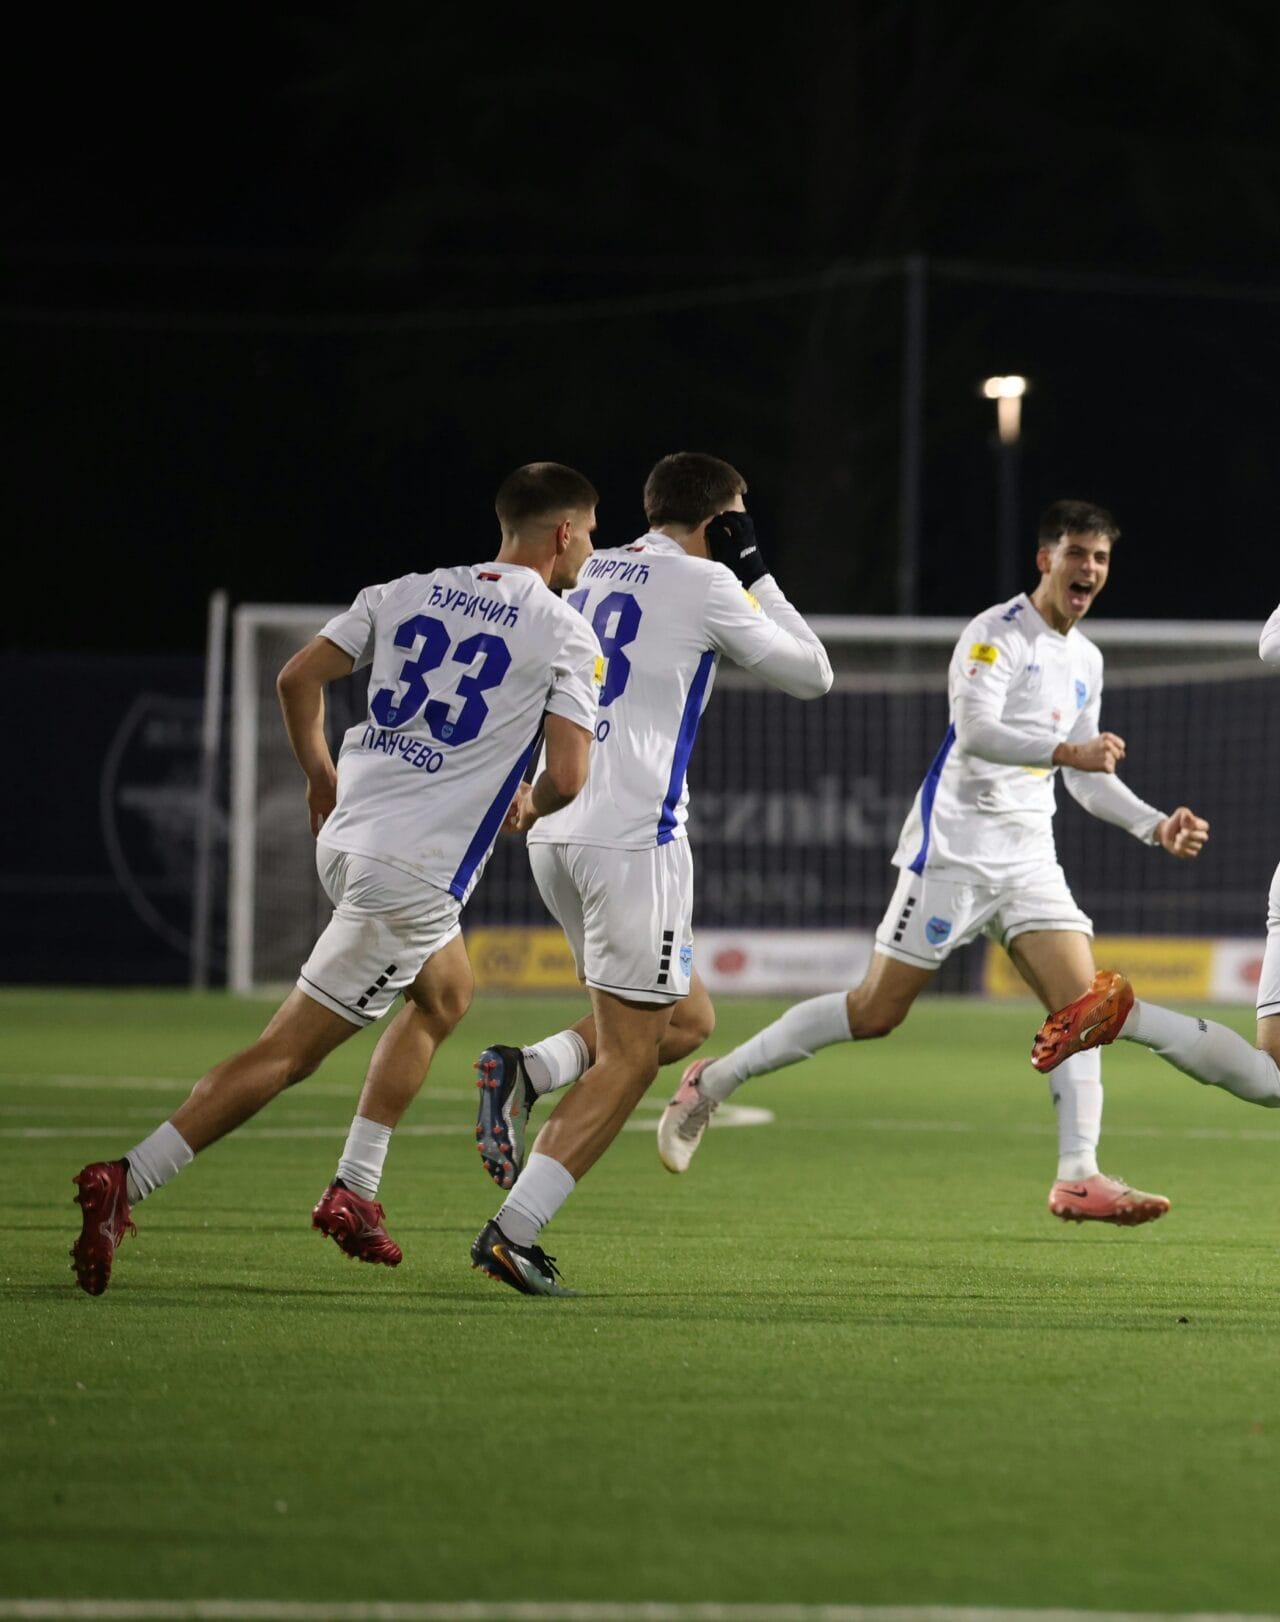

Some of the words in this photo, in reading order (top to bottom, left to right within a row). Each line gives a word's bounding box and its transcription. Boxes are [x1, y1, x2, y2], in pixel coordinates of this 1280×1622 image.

[583, 558, 650, 585] ПИРГИЋ
[428, 584, 520, 629] ЂУРИЧИЋ
[370, 613, 513, 747] 33
[360, 724, 445, 774] ПАНЧЕВО
